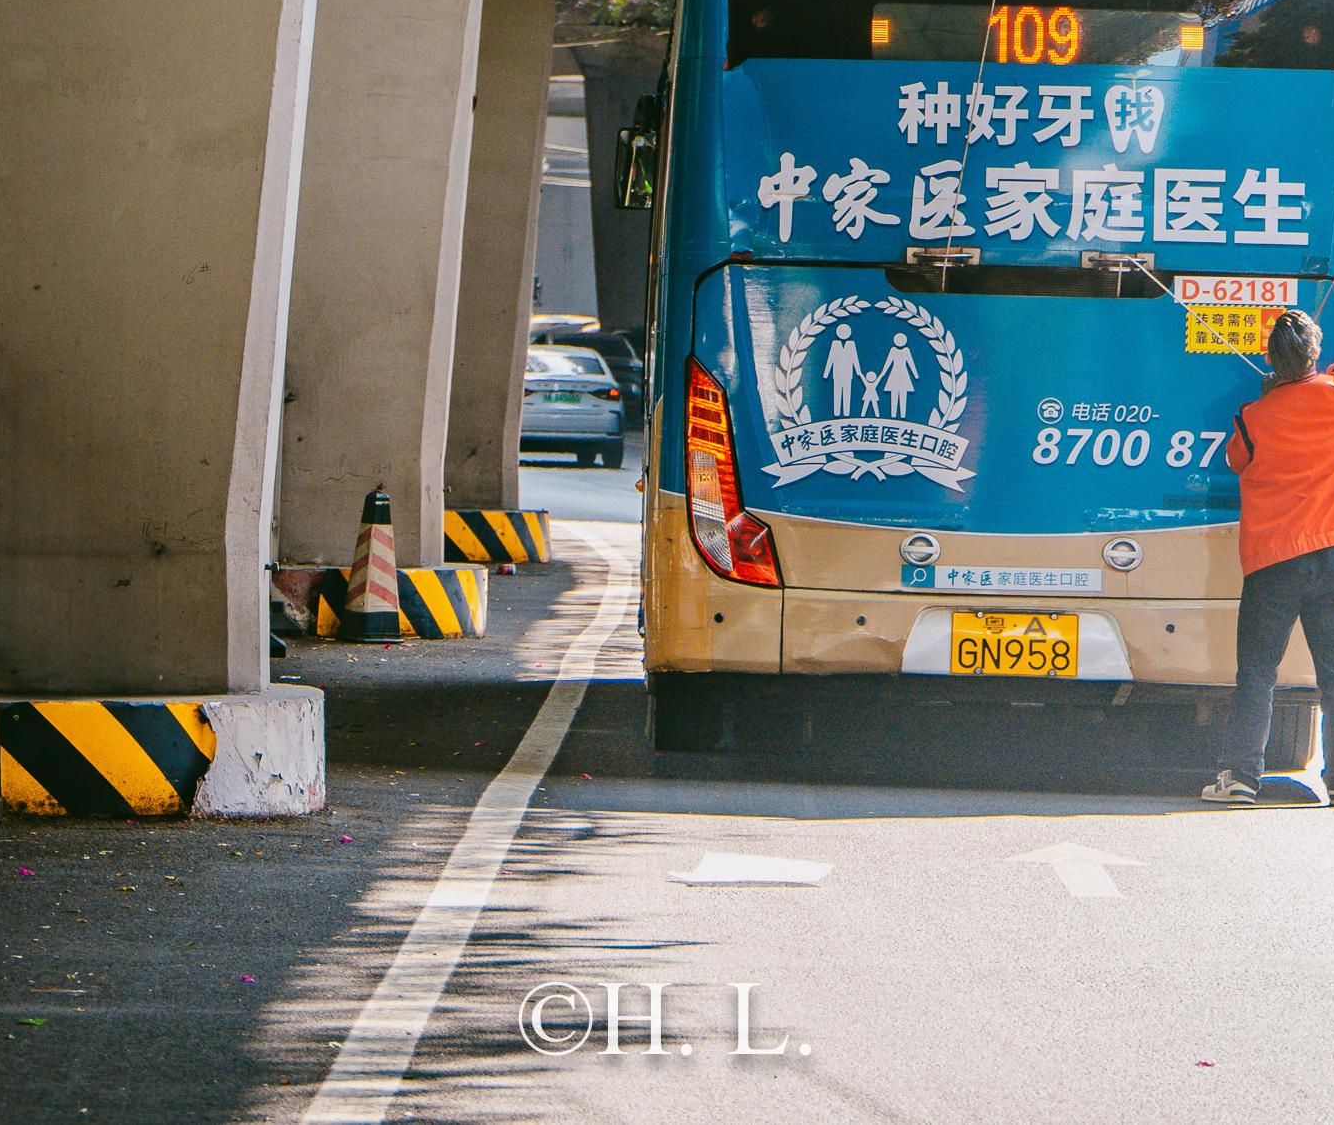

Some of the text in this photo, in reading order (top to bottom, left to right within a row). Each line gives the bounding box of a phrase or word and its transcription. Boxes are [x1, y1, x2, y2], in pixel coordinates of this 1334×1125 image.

[989, 6, 1080, 65] 109
[1181, 279, 1289, 303] D-62181
[1195, 313, 1257, 328] 转弯需停
[1194, 331, 1257, 346] 靠站需停
[1071, 402, 1160, 423] 电话 020-
[1032, 427, 1231, 468] 8700 87
[957, 638, 1071, 671] GN958
